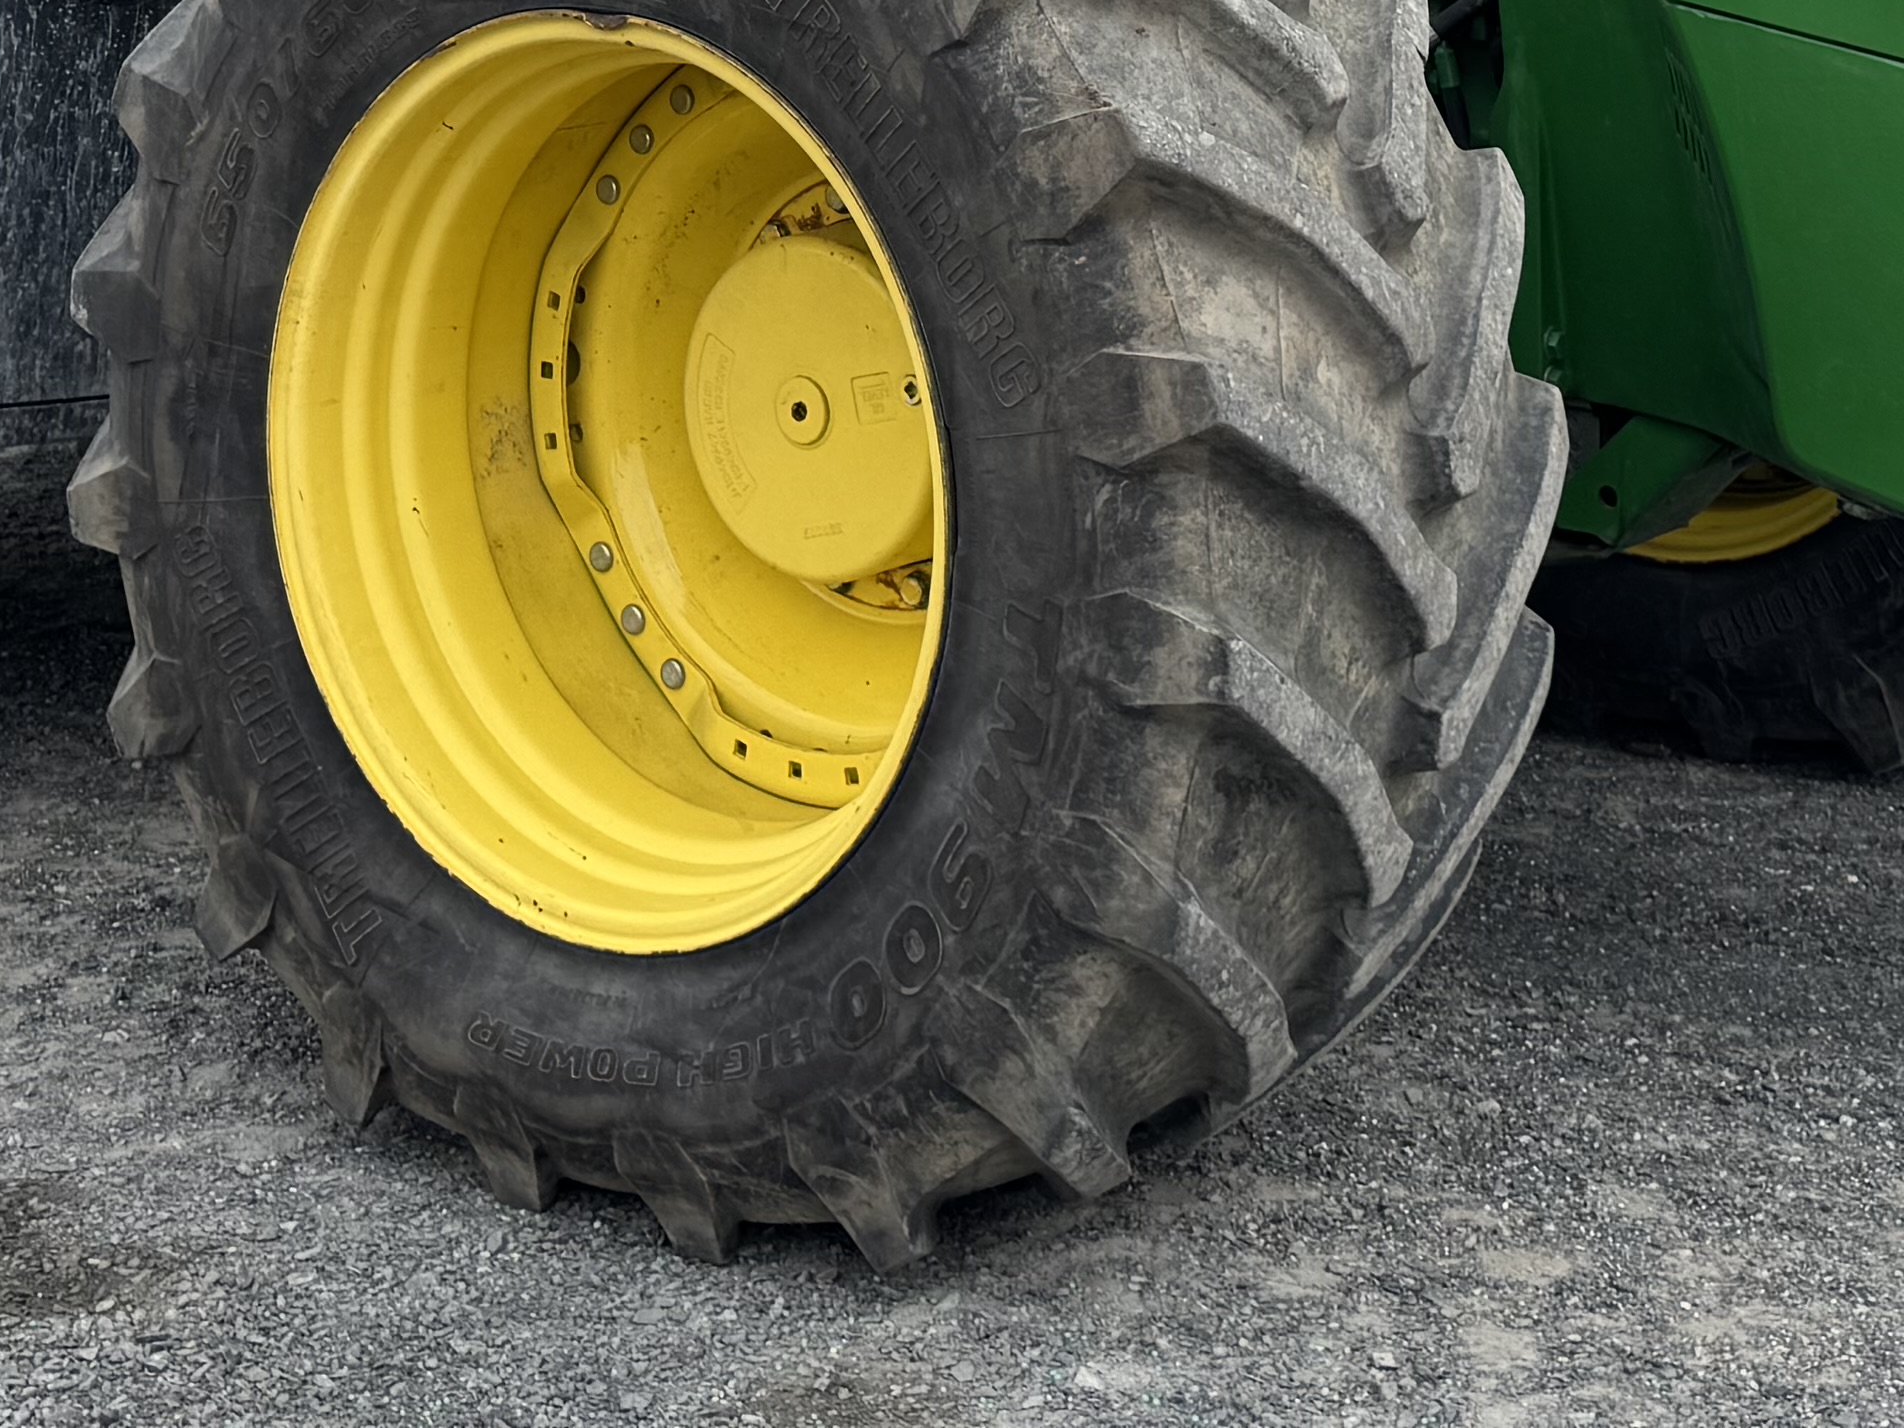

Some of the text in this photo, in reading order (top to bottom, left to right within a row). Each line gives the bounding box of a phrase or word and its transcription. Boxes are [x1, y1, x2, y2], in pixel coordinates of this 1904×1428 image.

[174, 523, 383, 966] TRELLEBORG
[466, 1011, 663, 1087] POWER
[676, 1016, 820, 1088] HIGH
